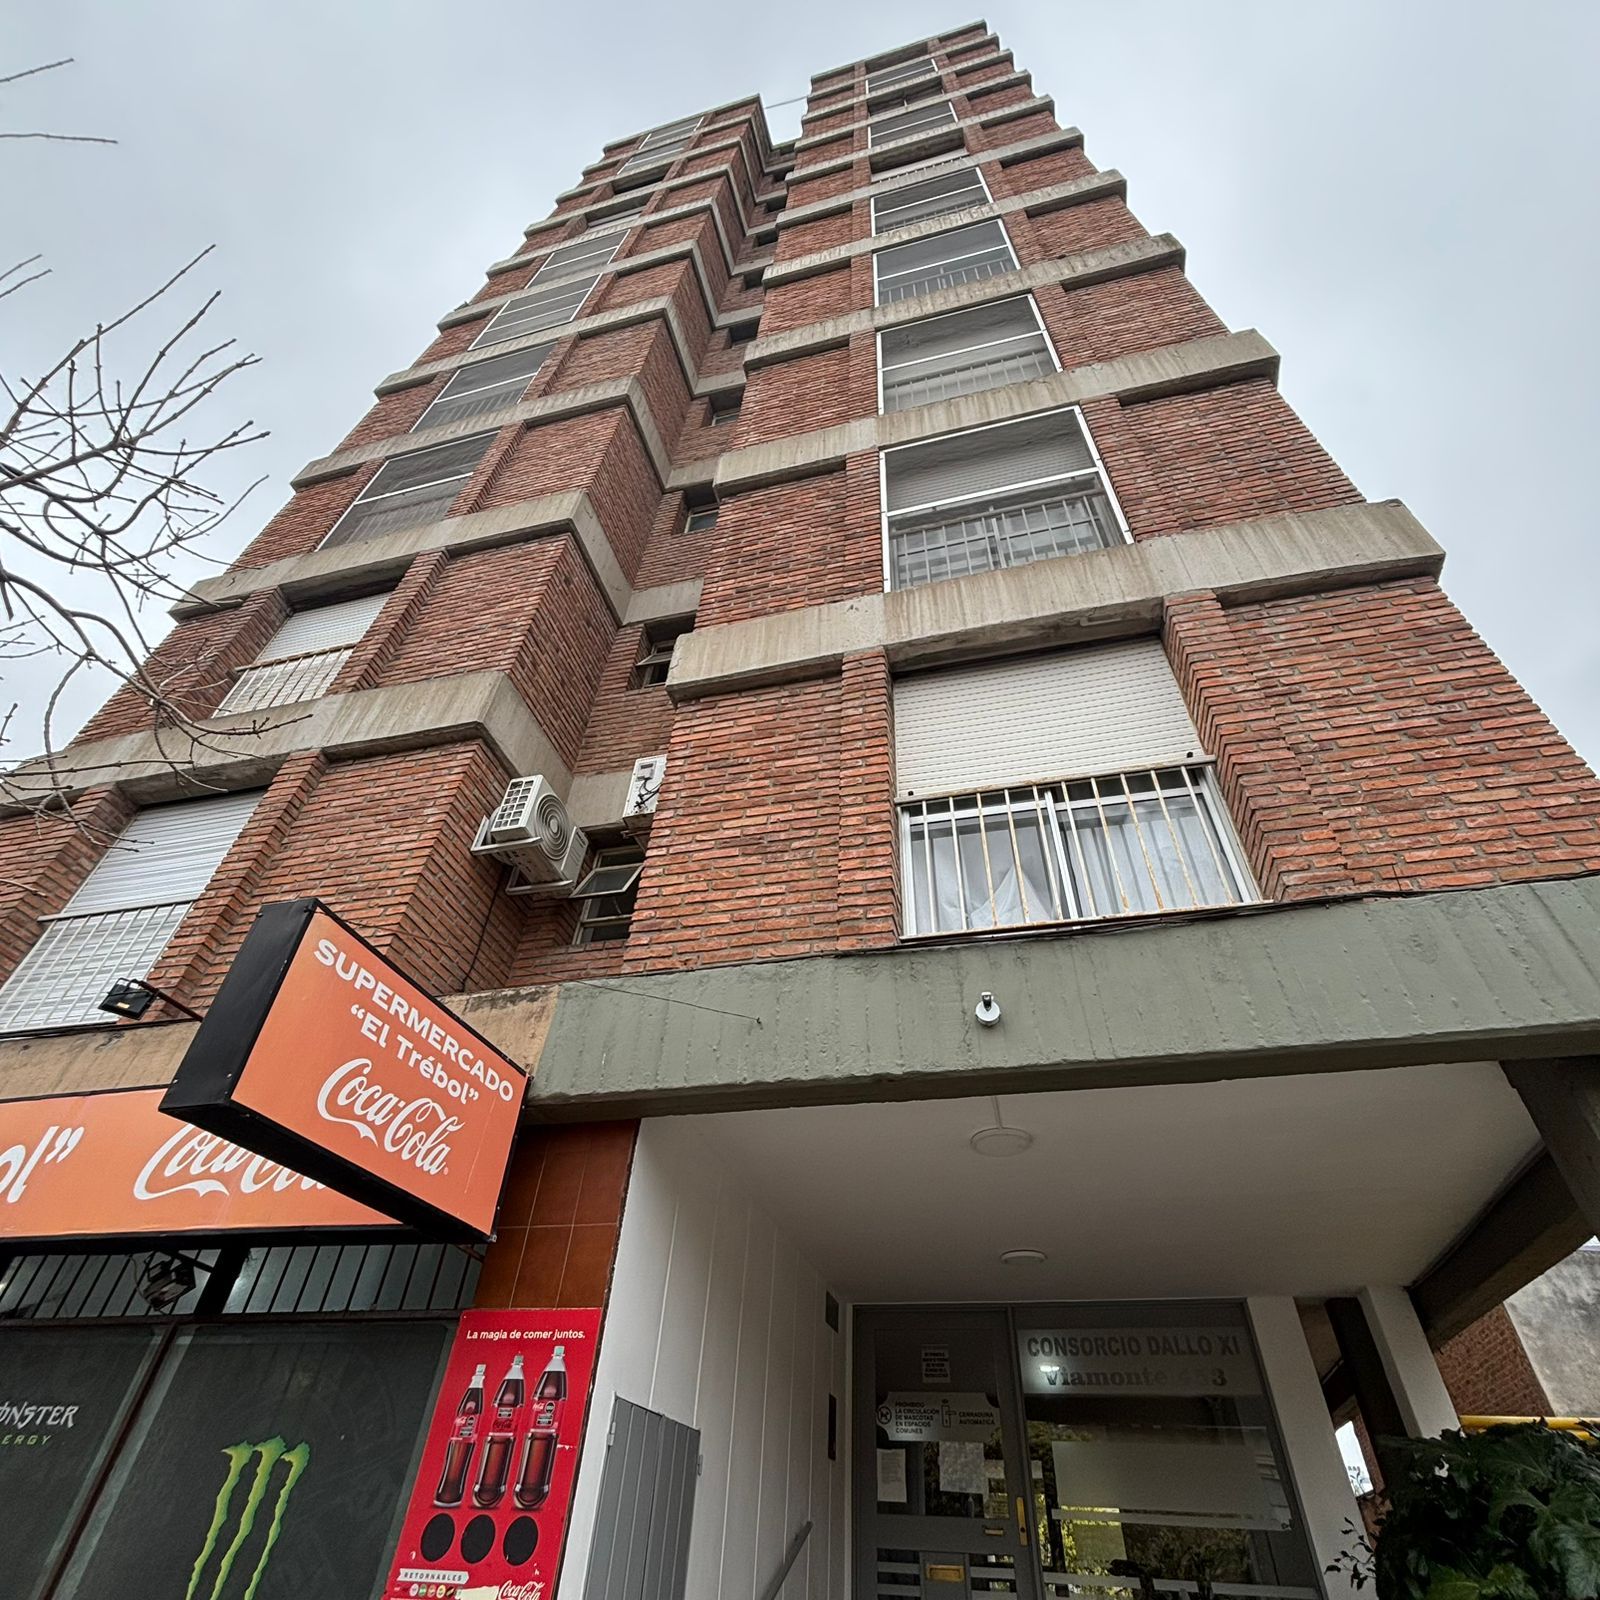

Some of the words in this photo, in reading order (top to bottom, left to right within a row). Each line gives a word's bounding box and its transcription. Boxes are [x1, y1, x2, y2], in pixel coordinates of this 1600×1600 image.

[313, 939, 514, 1102] SUPERMERCADO
[350, 1004, 390, 1049] “El
[396, 1034, 480, 1105] Trébol”
[317, 1057, 465, 1175] Coca-Cola
[466, 1330, 478, 1339] La
[480, 1329, 507, 1341] magia
[510, 1329, 522, 1339] de
[523, 1330, 552, 1339] comer
[553, 1328, 586, 1341] juntos.
[1027, 1336, 1141, 1357] CONSORCIO
[1147, 1335, 1213, 1356] DALLO
[1216, 1335, 1241, 1356] XI
[1045, 1366, 1168, 1387] Viamonte
[404, 1571, 463, 1582] RETORNABLES
